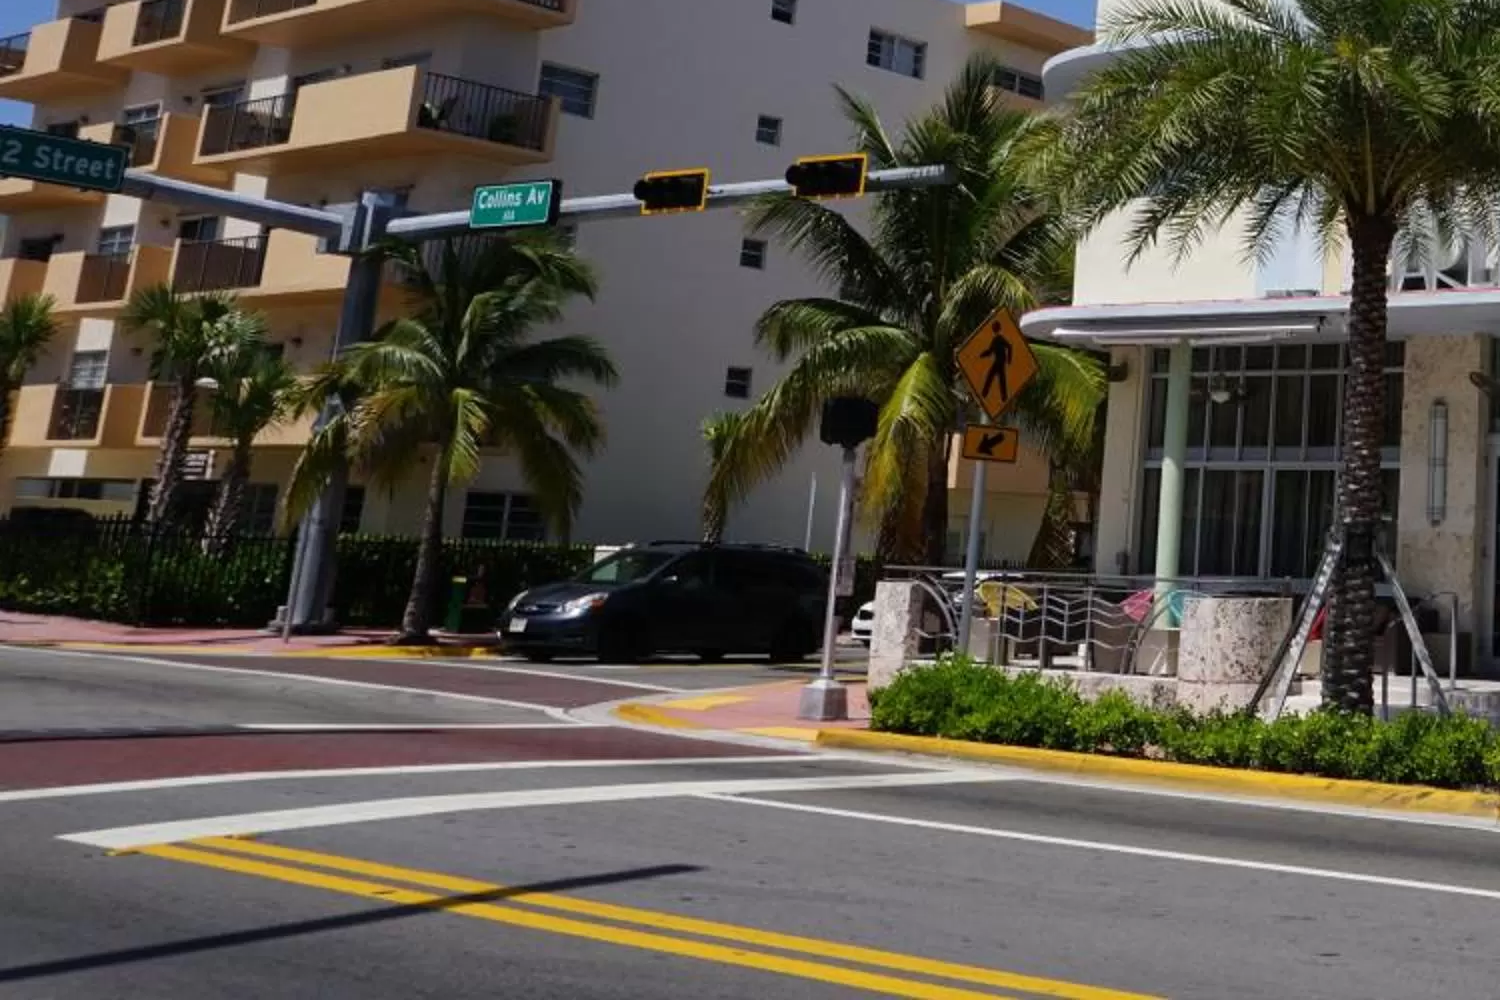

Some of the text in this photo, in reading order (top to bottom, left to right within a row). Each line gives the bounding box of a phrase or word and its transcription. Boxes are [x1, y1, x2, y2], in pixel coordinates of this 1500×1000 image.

[0, 137, 115, 180] 2 Street
[478, 190, 524, 209] Collins
